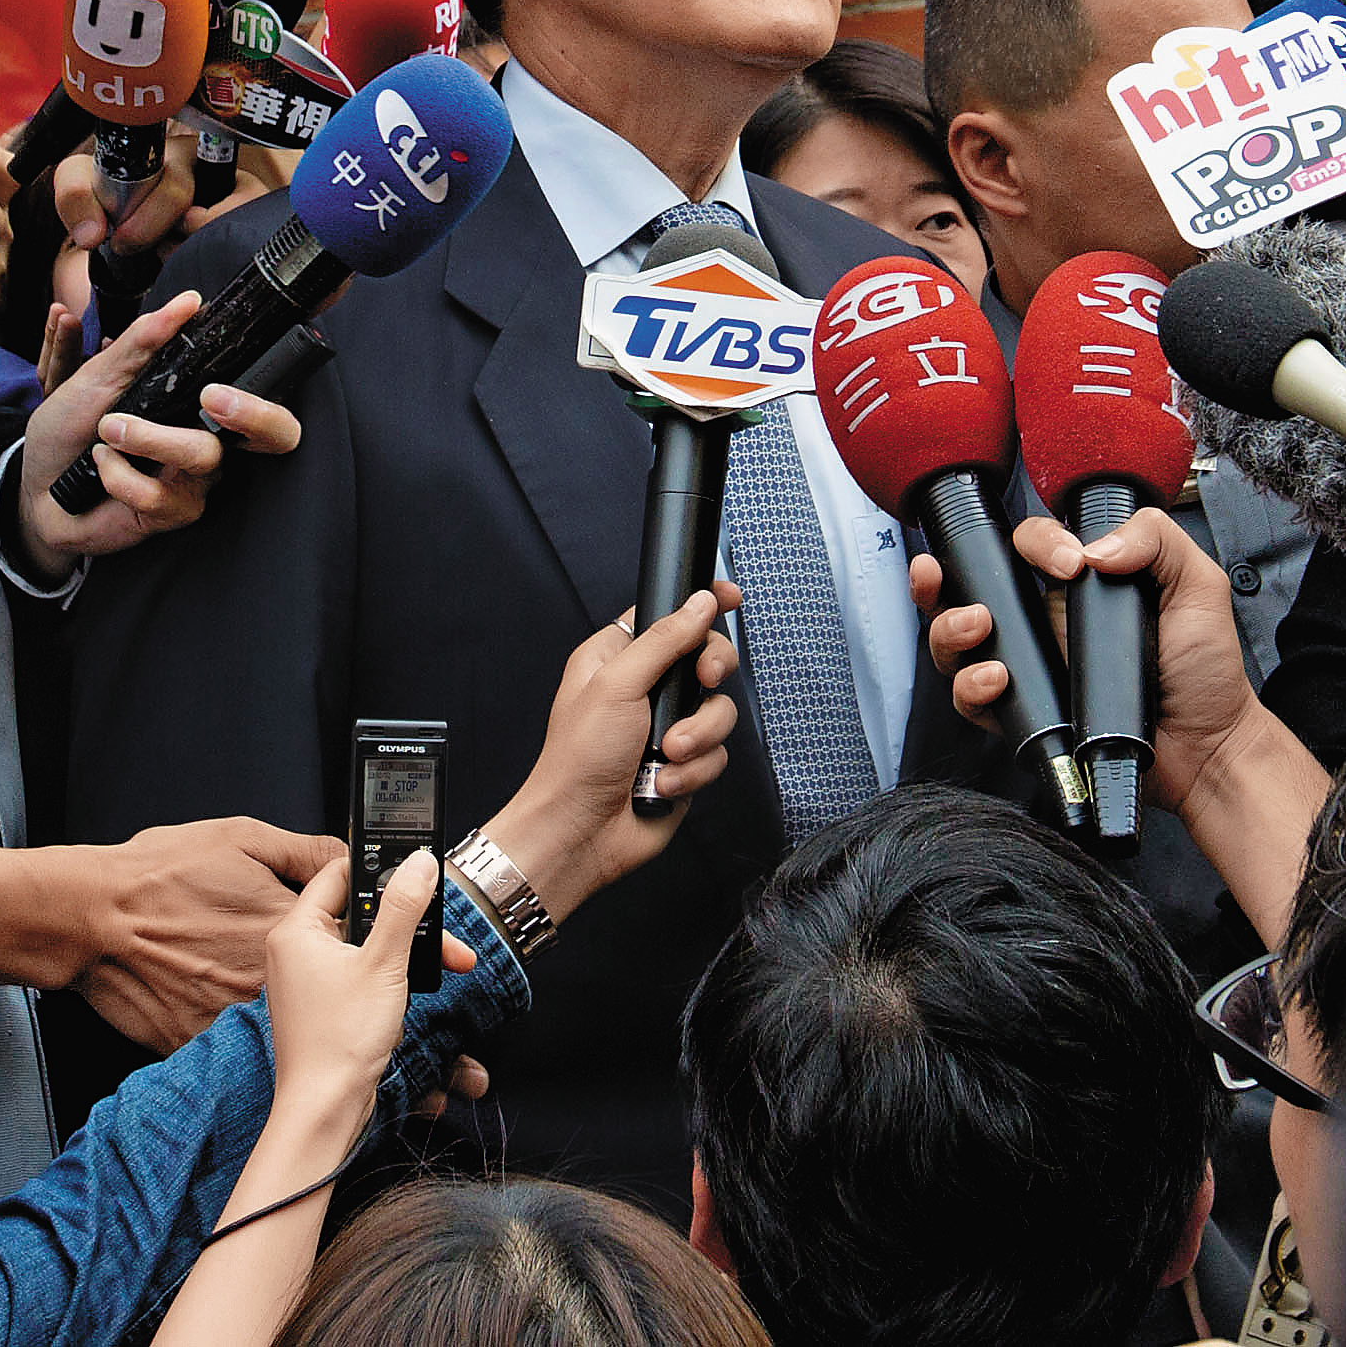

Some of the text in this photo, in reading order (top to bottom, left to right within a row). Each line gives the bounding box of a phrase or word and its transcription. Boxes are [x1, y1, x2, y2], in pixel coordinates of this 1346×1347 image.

[232, 8, 274, 54] CTS
[64, 54, 165, 107] udn
[1119, 45, 1270, 144] hit
[1259, 28, 1332, 91] FM
[240, 82, 332, 140] 華視
[331, 150, 406, 231] 中天
[1190, 181, 1293, 234] radio
[611, 294, 813, 377] TVBS
[834, 335, 979, 434] 三立
[378, 745, 426, 753] OLYMPUS
[395, 781, 418, 792] STOP
